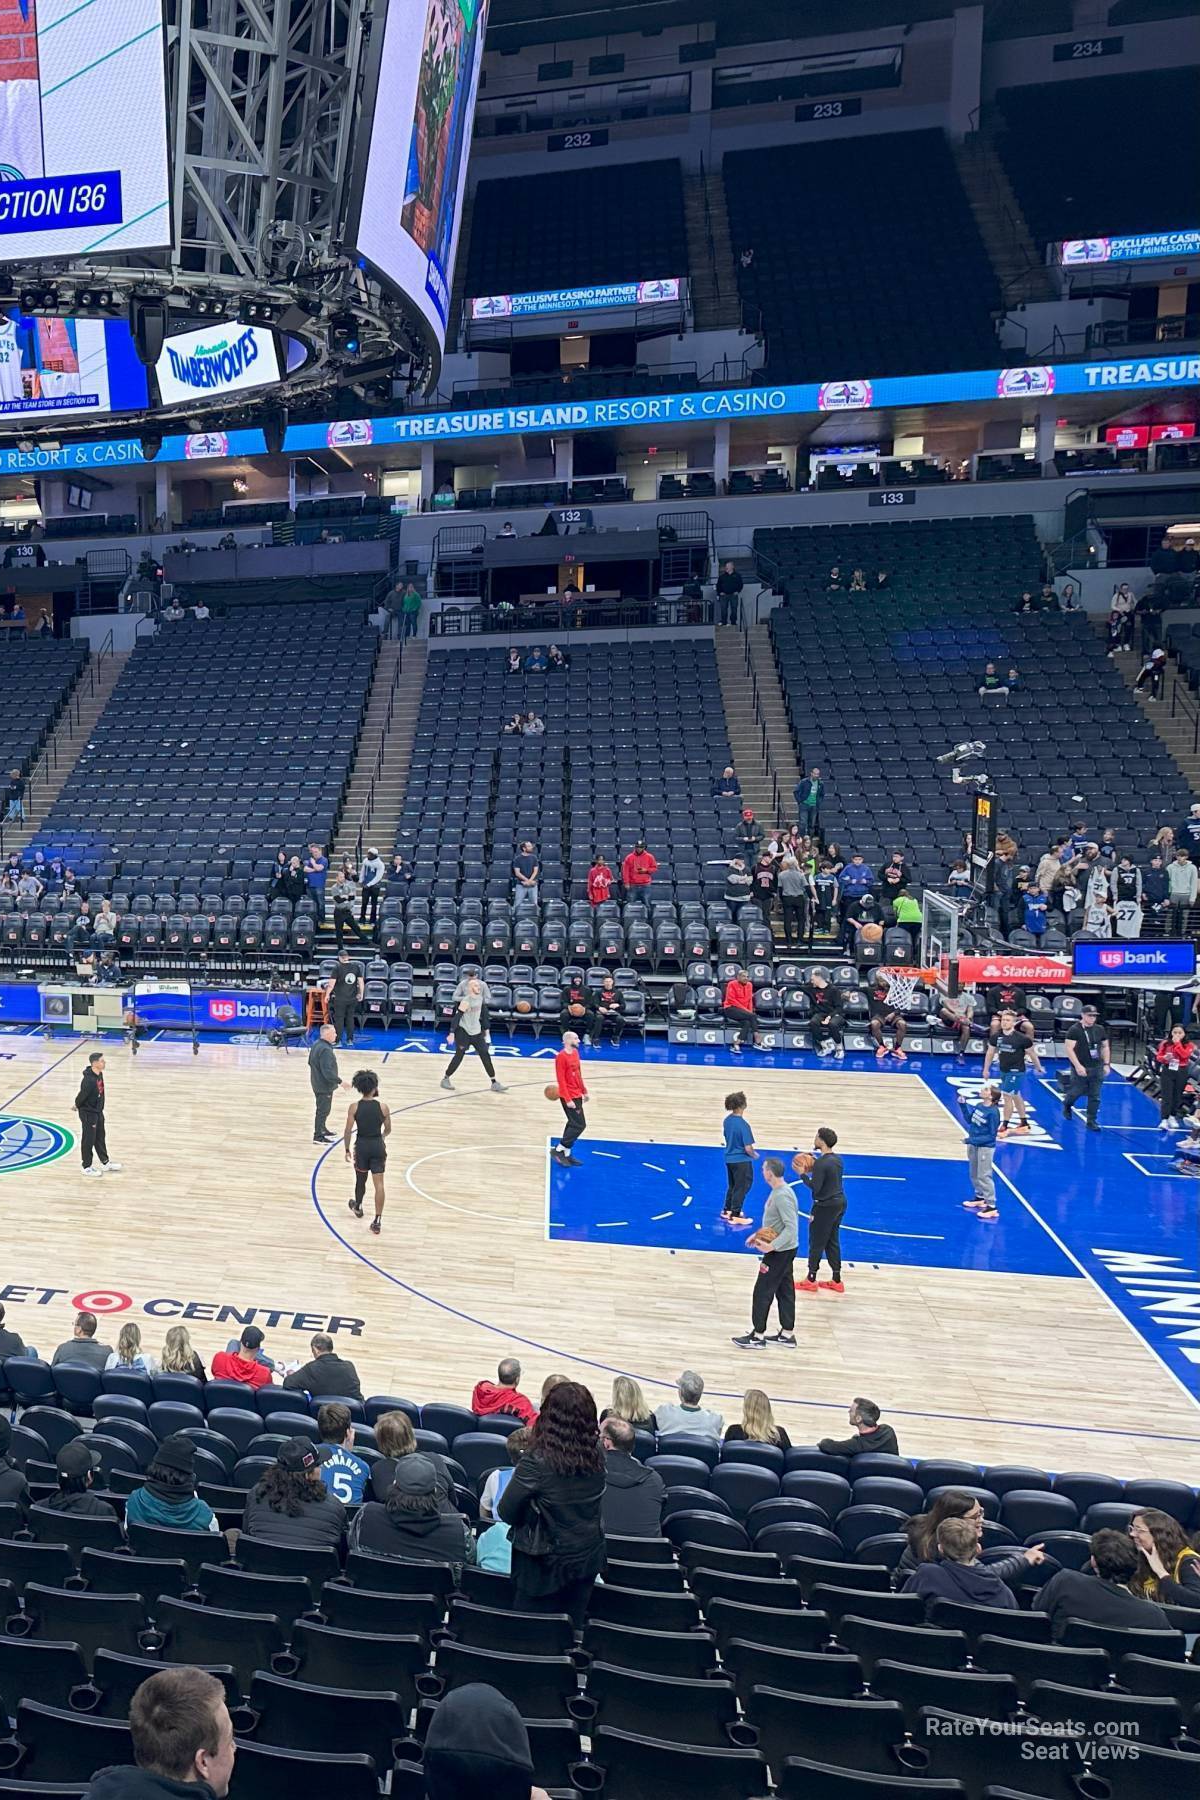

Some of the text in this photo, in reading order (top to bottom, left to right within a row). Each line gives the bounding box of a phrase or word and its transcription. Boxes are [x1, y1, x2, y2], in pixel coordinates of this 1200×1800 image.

[1072, 42, 1103, 58] 234
[813, 102, 842, 118] 233
[564, 133, 592, 148] 232
[68, 184, 108, 214] 136
[1111, 233, 1200, 249] EXCLUSIVE CASIN
[1125, 248, 1140, 256] THE
[1141, 243, 1193, 254] MINNESOTA
[512, 293, 558, 305] EXCLUSIVE
[560, 290, 594, 300] CASINO
[596, 286, 637, 297] PARTNER
[539, 300, 579, 310] MINNESOTA
[582, 295, 636, 306] TIMBERWOLVES
[0, 352, 10, 363] 32
[166, 327, 258, 388] TIMBERWOLVES
[1084, 359, 1200, 386] TREASUR
[11, 402, 21, 410] THE
[22, 401, 37, 409] TEAM
[38, 400, 55, 408] STORE
[62, 397, 86, 406] SECTION
[397, 391, 785, 436] TREASURE ISLAND RESORT & CASINO
[7, 449, 71, 468] RESORT
[75, 446, 88, 463] &
[93, 443, 143, 462] CASIN
[881, 492, 904, 504] 133
[560, 511, 581, 522] 132
[16, 546, 34, 556] 130
[1118, 910, 1135, 920] 27
[1102, 951, 1167, 964] us bank
[211, 1000, 278, 1018] us bank
[143, 1298, 366, 1336] CENTER
[333, 1472, 352, 1503] 5
